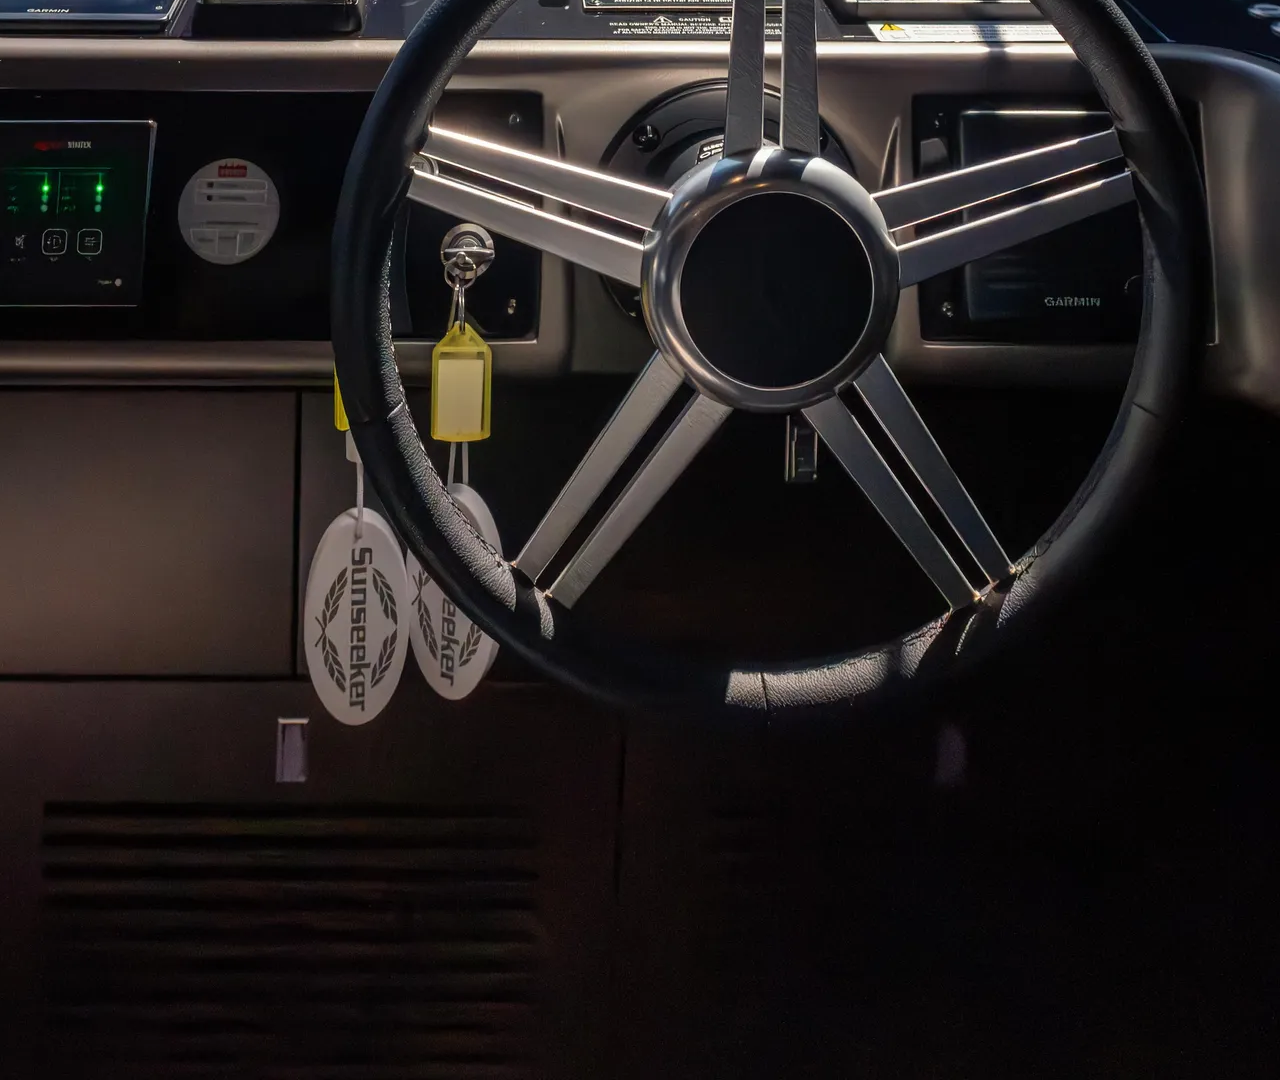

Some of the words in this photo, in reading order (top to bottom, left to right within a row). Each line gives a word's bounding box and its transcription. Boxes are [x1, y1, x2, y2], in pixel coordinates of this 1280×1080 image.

[1044, 296, 1101, 307] GARMIN
[349, 547, 373, 712] Sunseeker
[440, 597, 460, 687] eeker
